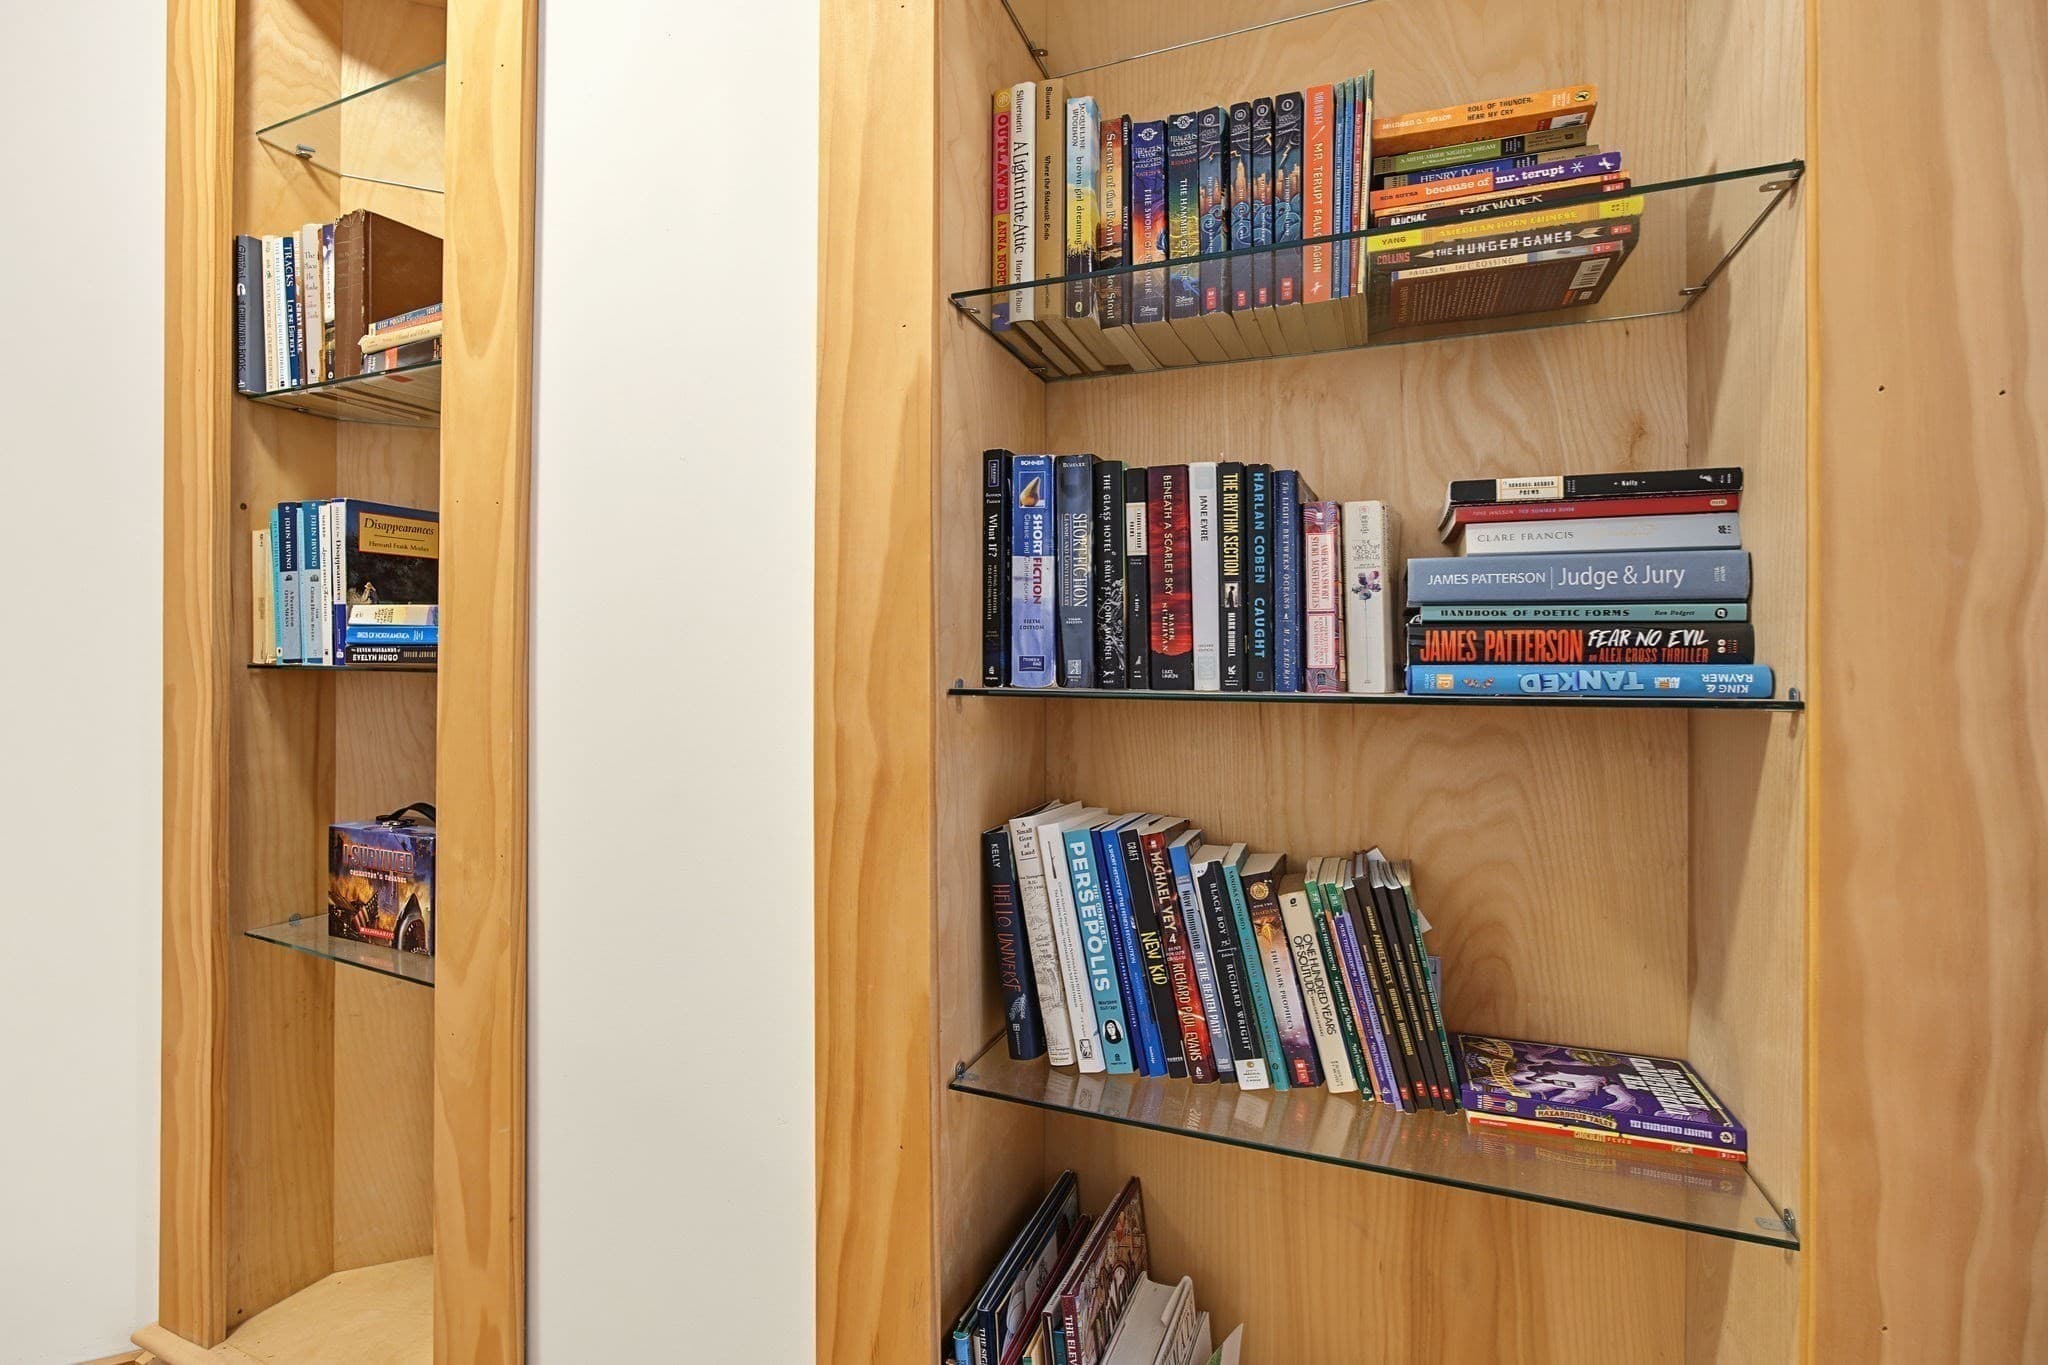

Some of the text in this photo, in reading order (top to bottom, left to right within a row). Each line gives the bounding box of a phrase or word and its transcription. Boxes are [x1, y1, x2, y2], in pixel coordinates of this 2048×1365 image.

[1015, 90, 1024, 133] Silverstein
[1044, 87, 1052, 120] Silverstein
[1467, 104, 1484, 113] ROLL
[1487, 102, 1497, 110] OF
[1467, 108, 1514, 121] HEAR MY CRY
[1071, 108, 1079, 146] WOODSON
[1078, 103, 1086, 151] JACQUELINE
[997, 115, 1009, 211] OUTLAWED
[1106, 133, 1115, 172] Secrets
[1313, 143, 1323, 162] MR.
[1106, 175, 1116, 187] of
[1313, 166, 1322, 204] TERUPT
[1420, 171, 1457, 183] HENRY
[1425, 165, 1565, 195] because of mr. terupt
[1012, 142, 1029, 254] A Light in the Attic
[1074, 156, 1084, 246] brown girl dreaming
[1106, 211, 1116, 246] Realm
[1390, 213, 1427, 226] BRUCHAC
[997, 221, 1007, 251] ANNA
[1382, 236, 1406, 246] YANG
[1435, 230, 1572, 257] THE HUNGER GAMES
[285, 245, 294, 287] TRACKS
[1313, 244, 1322, 273] AGAIN
[1377, 252, 1411, 265] COLLINS
[1103, 474, 1111, 490] THE
[1102, 494, 1111, 521] GLASS
[1198, 495, 1209, 542] JANE EYRE
[364, 517, 434, 536] Disappearances
[988, 514, 998, 557] What If?
[1072, 513, 1088, 552] SHORT
[1103, 525, 1112, 553] HOTEL
[1163, 475, 1173, 596] BENEATH A SCARLET SKY
[1223, 473, 1239, 576] THE RHYTHM SECTION
[1477, 531, 1574, 543] CLARE FRANCIS
[369, 540, 391, 549] Howard
[1311, 536, 1319, 558] STORY
[1032, 514, 1043, 605] SHORT FICTION
[1104, 559, 1112, 583] EMILY
[1254, 473, 1265, 658] HARLAN COBEN CAUGHT
[1320, 543, 1328, 578] AMERICAN
[1073, 557, 1088, 607] FICTION
[1311, 561, 1321, 609] MASTERPIECES
[1427, 566, 1685, 590] JAMES PATTERSON Judge & Jury
[1104, 599, 1112, 624] JOHN
[1440, 609, 1508, 618] HANDBOOK
[1512, 608, 1528, 617] OF
[1533, 608, 1581, 617] POETIC
[1584, 608, 1630, 617] FORMS
[1104, 627, 1112, 661] MANDEL
[1283, 628, 1290, 637] M.
[1283, 638, 1290, 646] L.
[1420, 628, 1709, 664] JAMES PATTERSON FEAR NO EVIL
[352, 653, 377, 661] EVELYN
[378, 653, 399, 661] HUGO
[1598, 647, 1709, 662] ALEX CROSS THRILLER
[1519, 669, 1645, 694] TANKED
[1702, 673, 1753, 683] RAYMER
[1707, 684, 1748, 694] KING &
[344, 844, 414, 875] I SURVIVED
[990, 844, 1001, 868] KELLY
[1127, 842, 1139, 861] CRAFT
[1149, 851, 1177, 943] MICHAEL VEY 4
[1182, 891, 1191, 907] New
[1069, 841, 1111, 992] PERSEPOLIS
[1092, 884, 1108, 945] THE COMPLETE
[1186, 908, 1201, 950] Hampshire
[1140, 931, 1159, 959] NEW
[1195, 952, 1205, 965] OFF
[1372, 934, 1393, 985] MINECRAFT
[996, 933, 1021, 992] UNIVERSE
[1199, 968, 1209, 981] THE
[1209, 883, 1251, 1051] BLACK BOY RICHARD WRIGHT
[1293, 935, 1316, 996] OF SOLITUDE
[1201, 984, 1216, 1013] BEATEN
[1270, 950, 1294, 1031] THE DARK PROPHECY
[1302, 934, 1336, 1035] ONE HUNDRED YEARS
[1172, 963, 1201, 1062] RICHARD PAUL EVANS
[1538, 1110, 1614, 1127] HAZARDOUS TALES
[1065, 1315, 1075, 1336] THE
